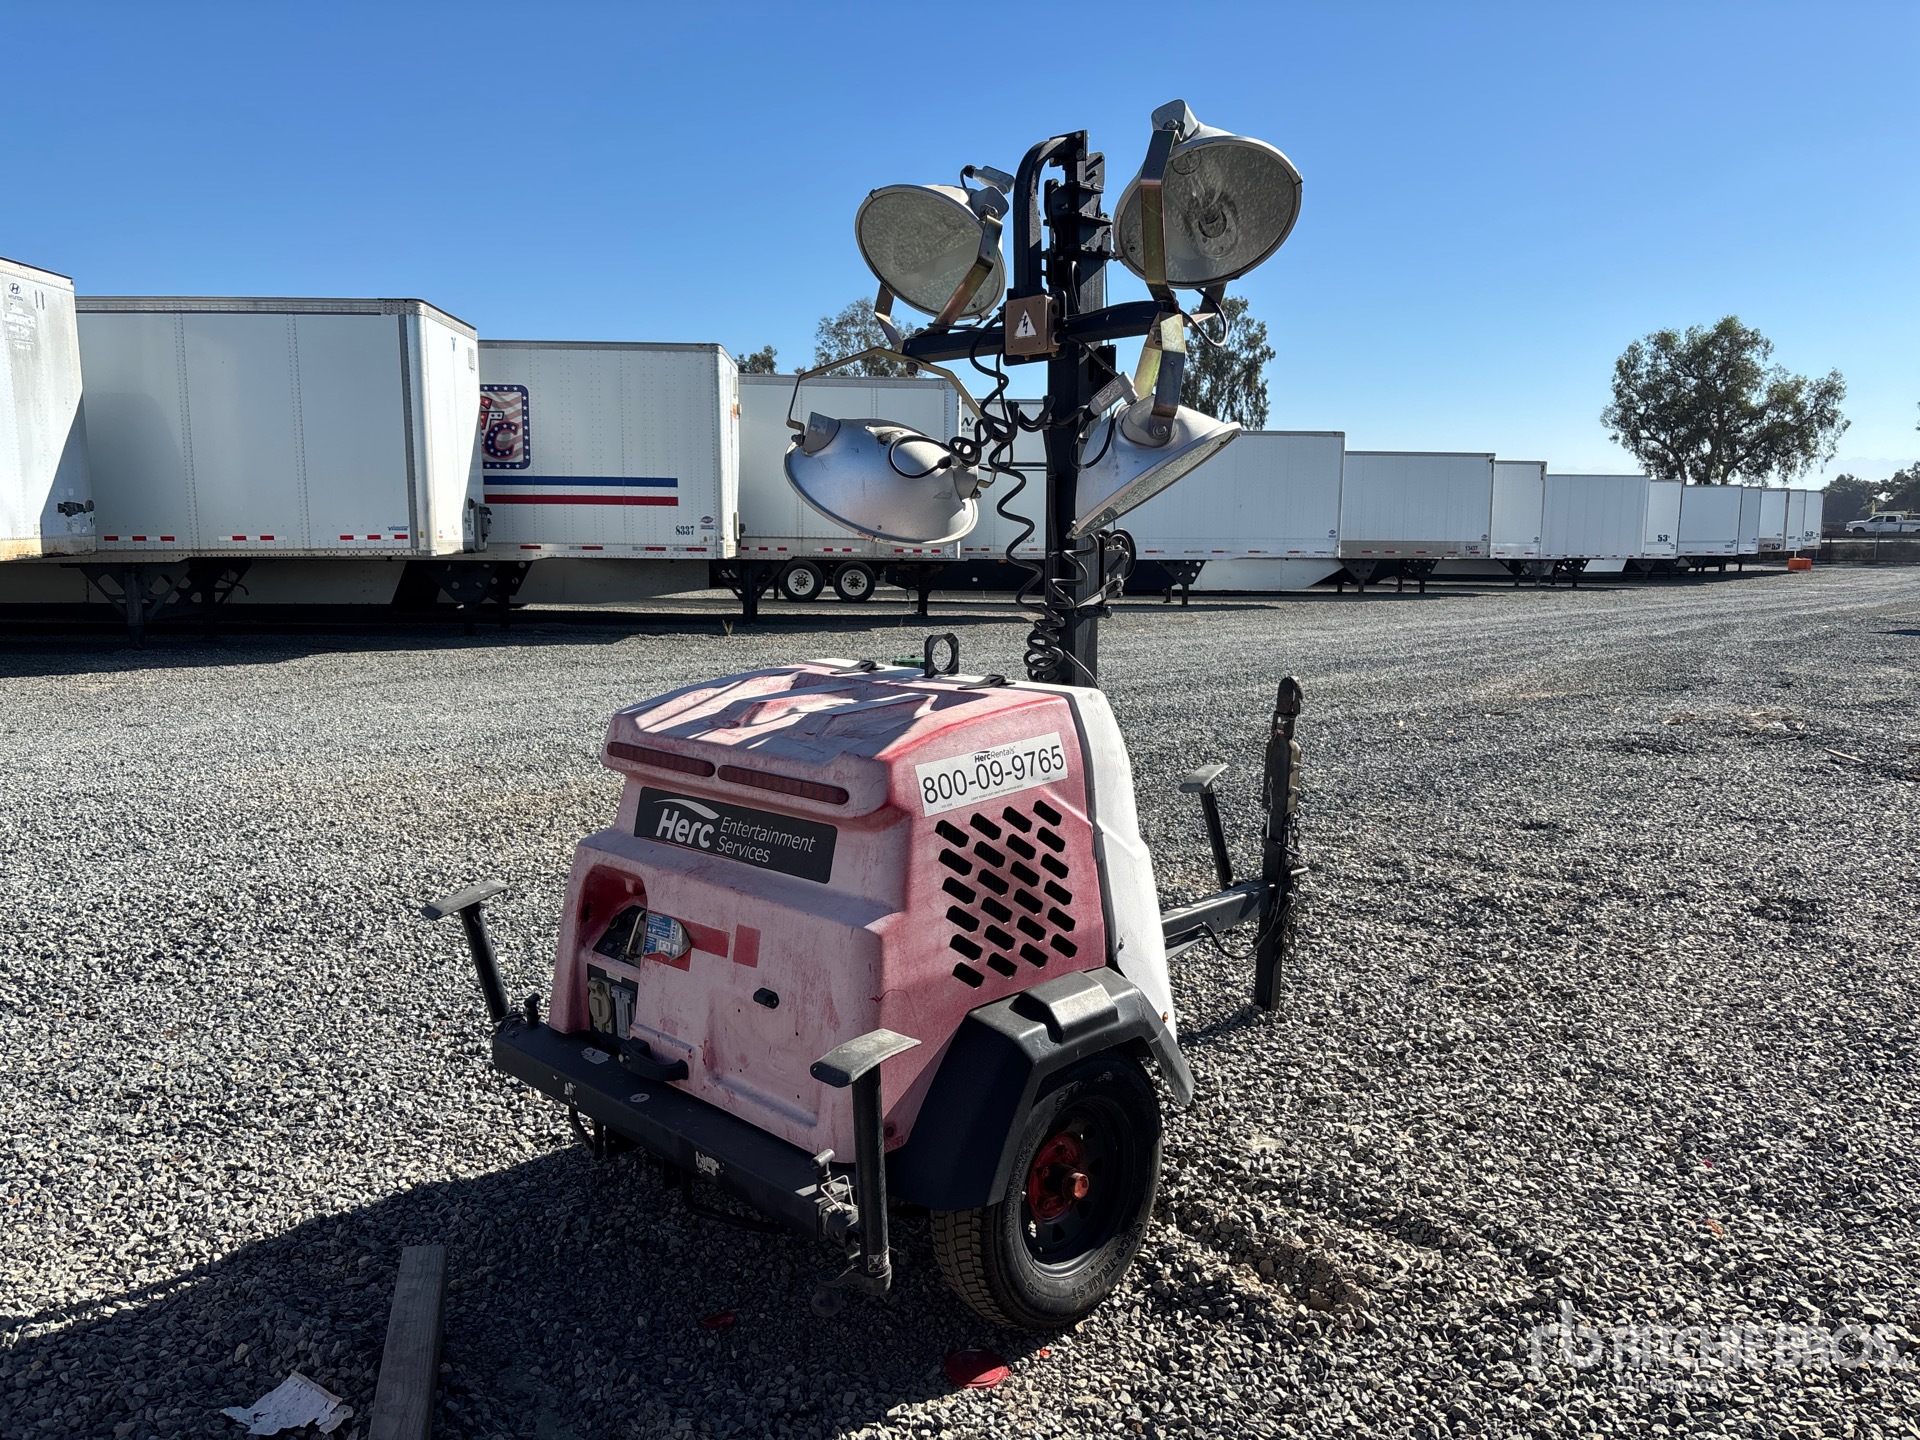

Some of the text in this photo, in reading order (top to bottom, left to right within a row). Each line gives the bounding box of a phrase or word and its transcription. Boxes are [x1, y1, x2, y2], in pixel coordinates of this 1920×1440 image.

[675, 525, 695, 536] 8337
[922, 744, 1065, 805] 800-09-9765
[655, 808, 715, 849] Herc
[719, 816, 816, 853] Entertainment
[716, 835, 771, 863] Services
